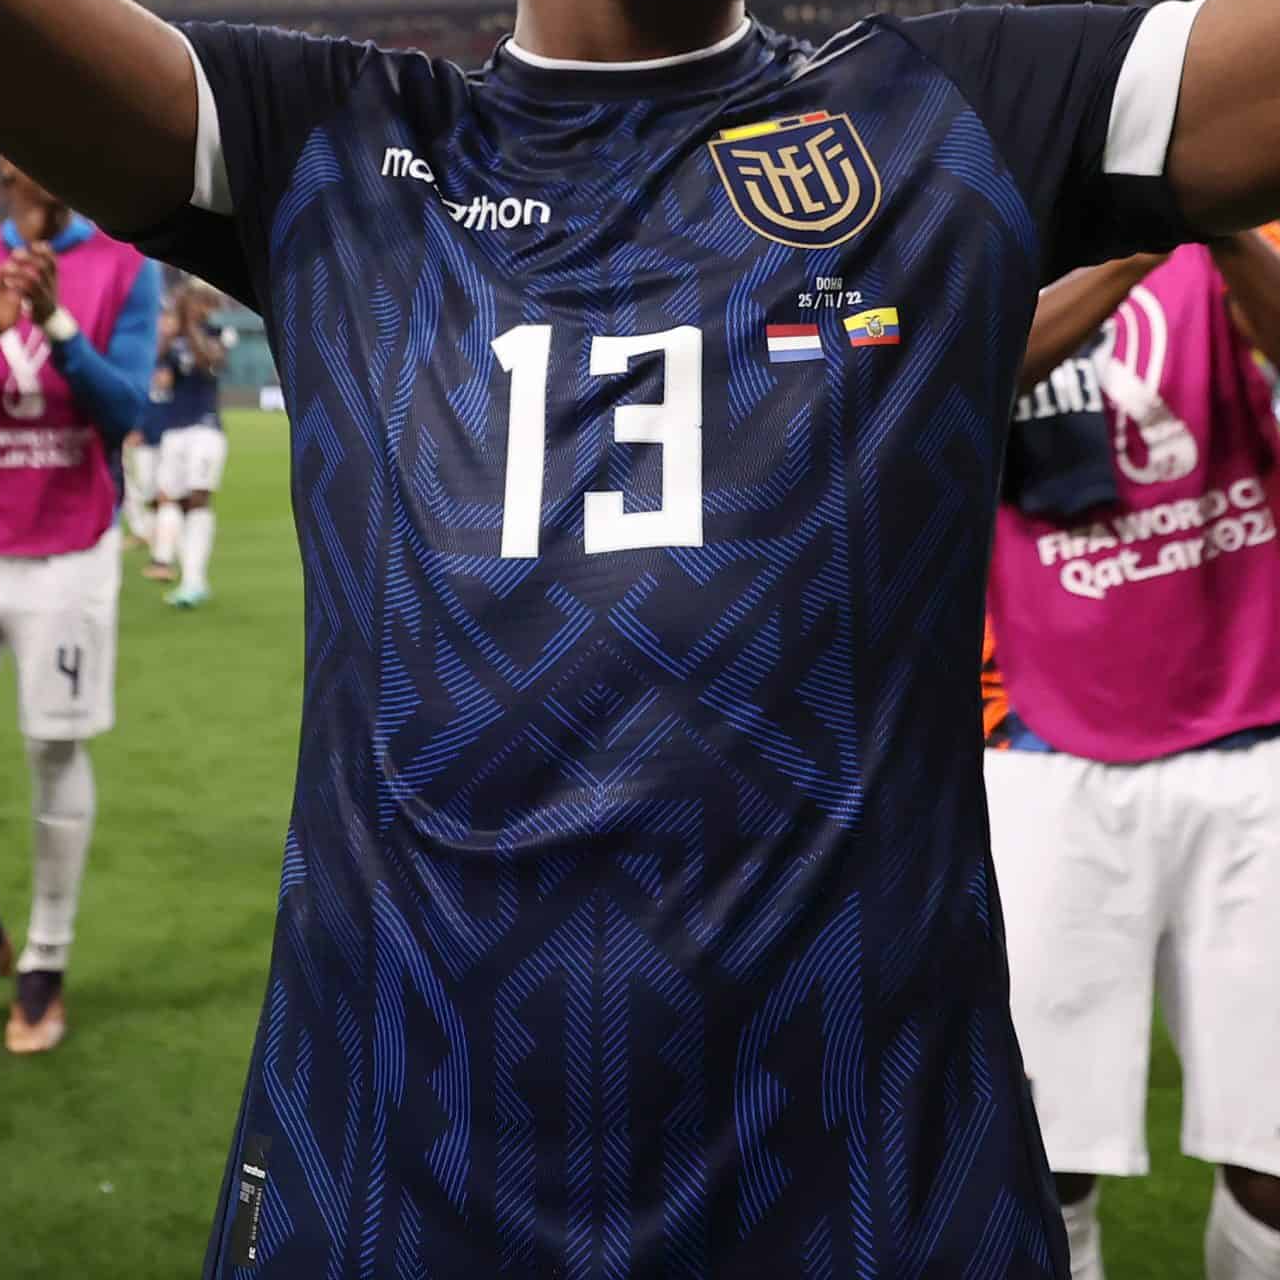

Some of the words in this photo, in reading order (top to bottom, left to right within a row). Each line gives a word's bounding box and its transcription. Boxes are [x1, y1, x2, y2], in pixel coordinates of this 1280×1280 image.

[381, 147, 552, 232] mathon
[815, 276, 843, 291] DOHA
[489, 324, 703, 559] 13
[1113, 489, 1228, 545] WORD
[1060, 537, 1205, 600] Qatar
[56, 645, 82, 699] 4
